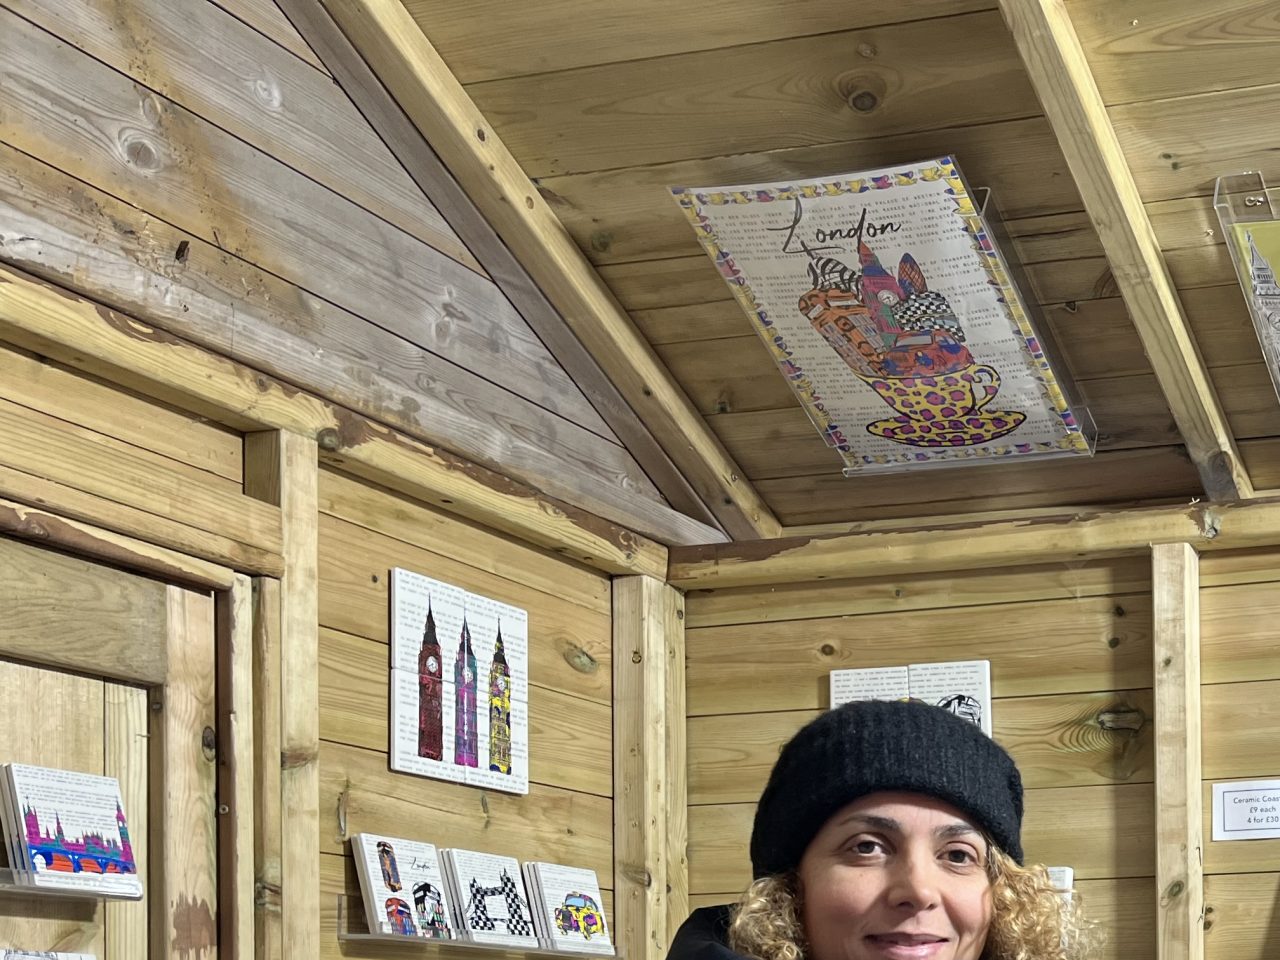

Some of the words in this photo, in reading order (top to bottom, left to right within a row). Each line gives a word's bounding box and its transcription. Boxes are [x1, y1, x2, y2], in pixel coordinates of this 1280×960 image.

[767, 197, 901, 254] London
[1233, 796, 1261, 804] Ceramic
[1249, 806, 1258, 814] £9
[1253, 816, 1263, 824] for
